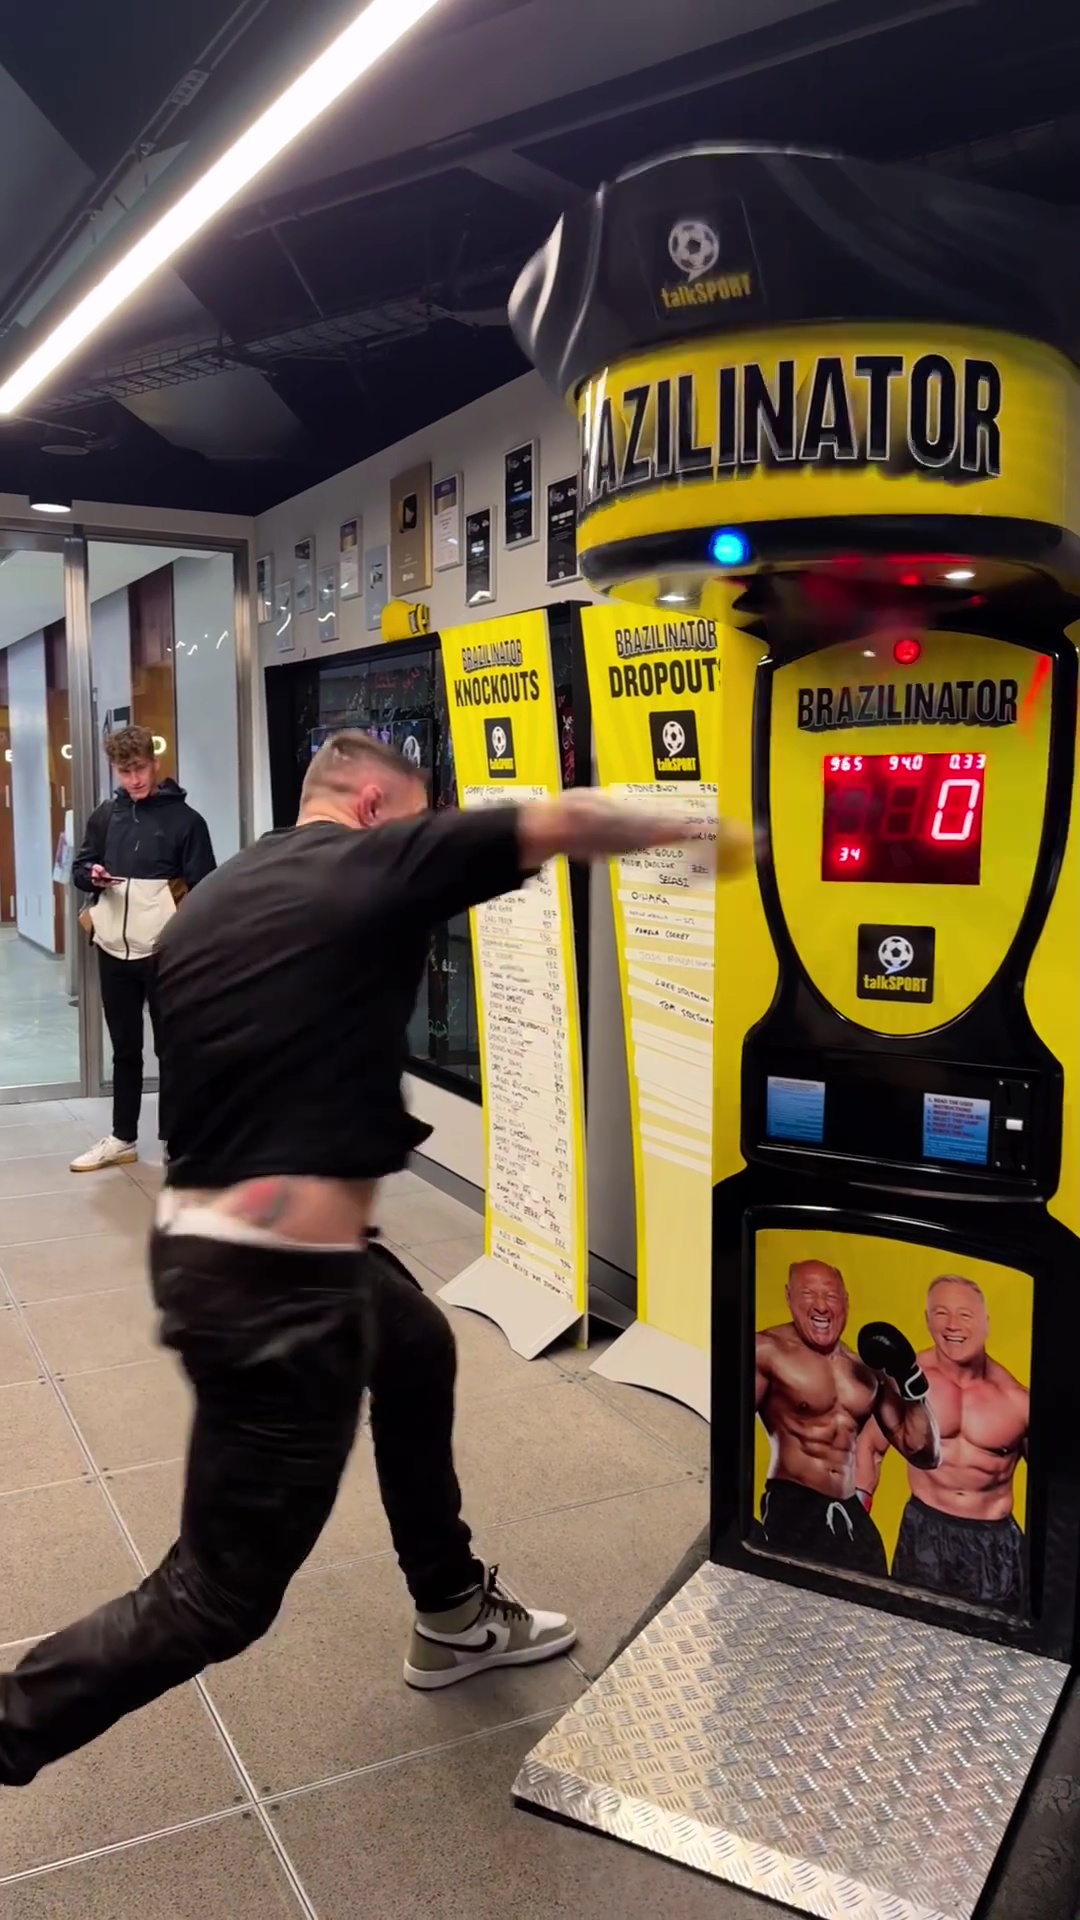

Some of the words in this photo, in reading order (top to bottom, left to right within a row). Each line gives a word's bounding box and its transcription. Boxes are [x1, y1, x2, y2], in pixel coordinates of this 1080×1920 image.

[661, 272, 751, 308] talkSPORT
[615, 619, 718, 660] BRAZILINATOR
[454, 669, 540, 707] KNOCKOUTS
[608, 657, 721, 698] DROPOUT
[797, 679, 1018, 731] BRAZILINATOR
[656, 757, 697, 772] talkSPORT
[931, 779, 980, 840] 0
[655, 848, 684, 858] GOULD
[839, 847, 861, 861] 34
[863, 974, 928, 993] talkSPORT
